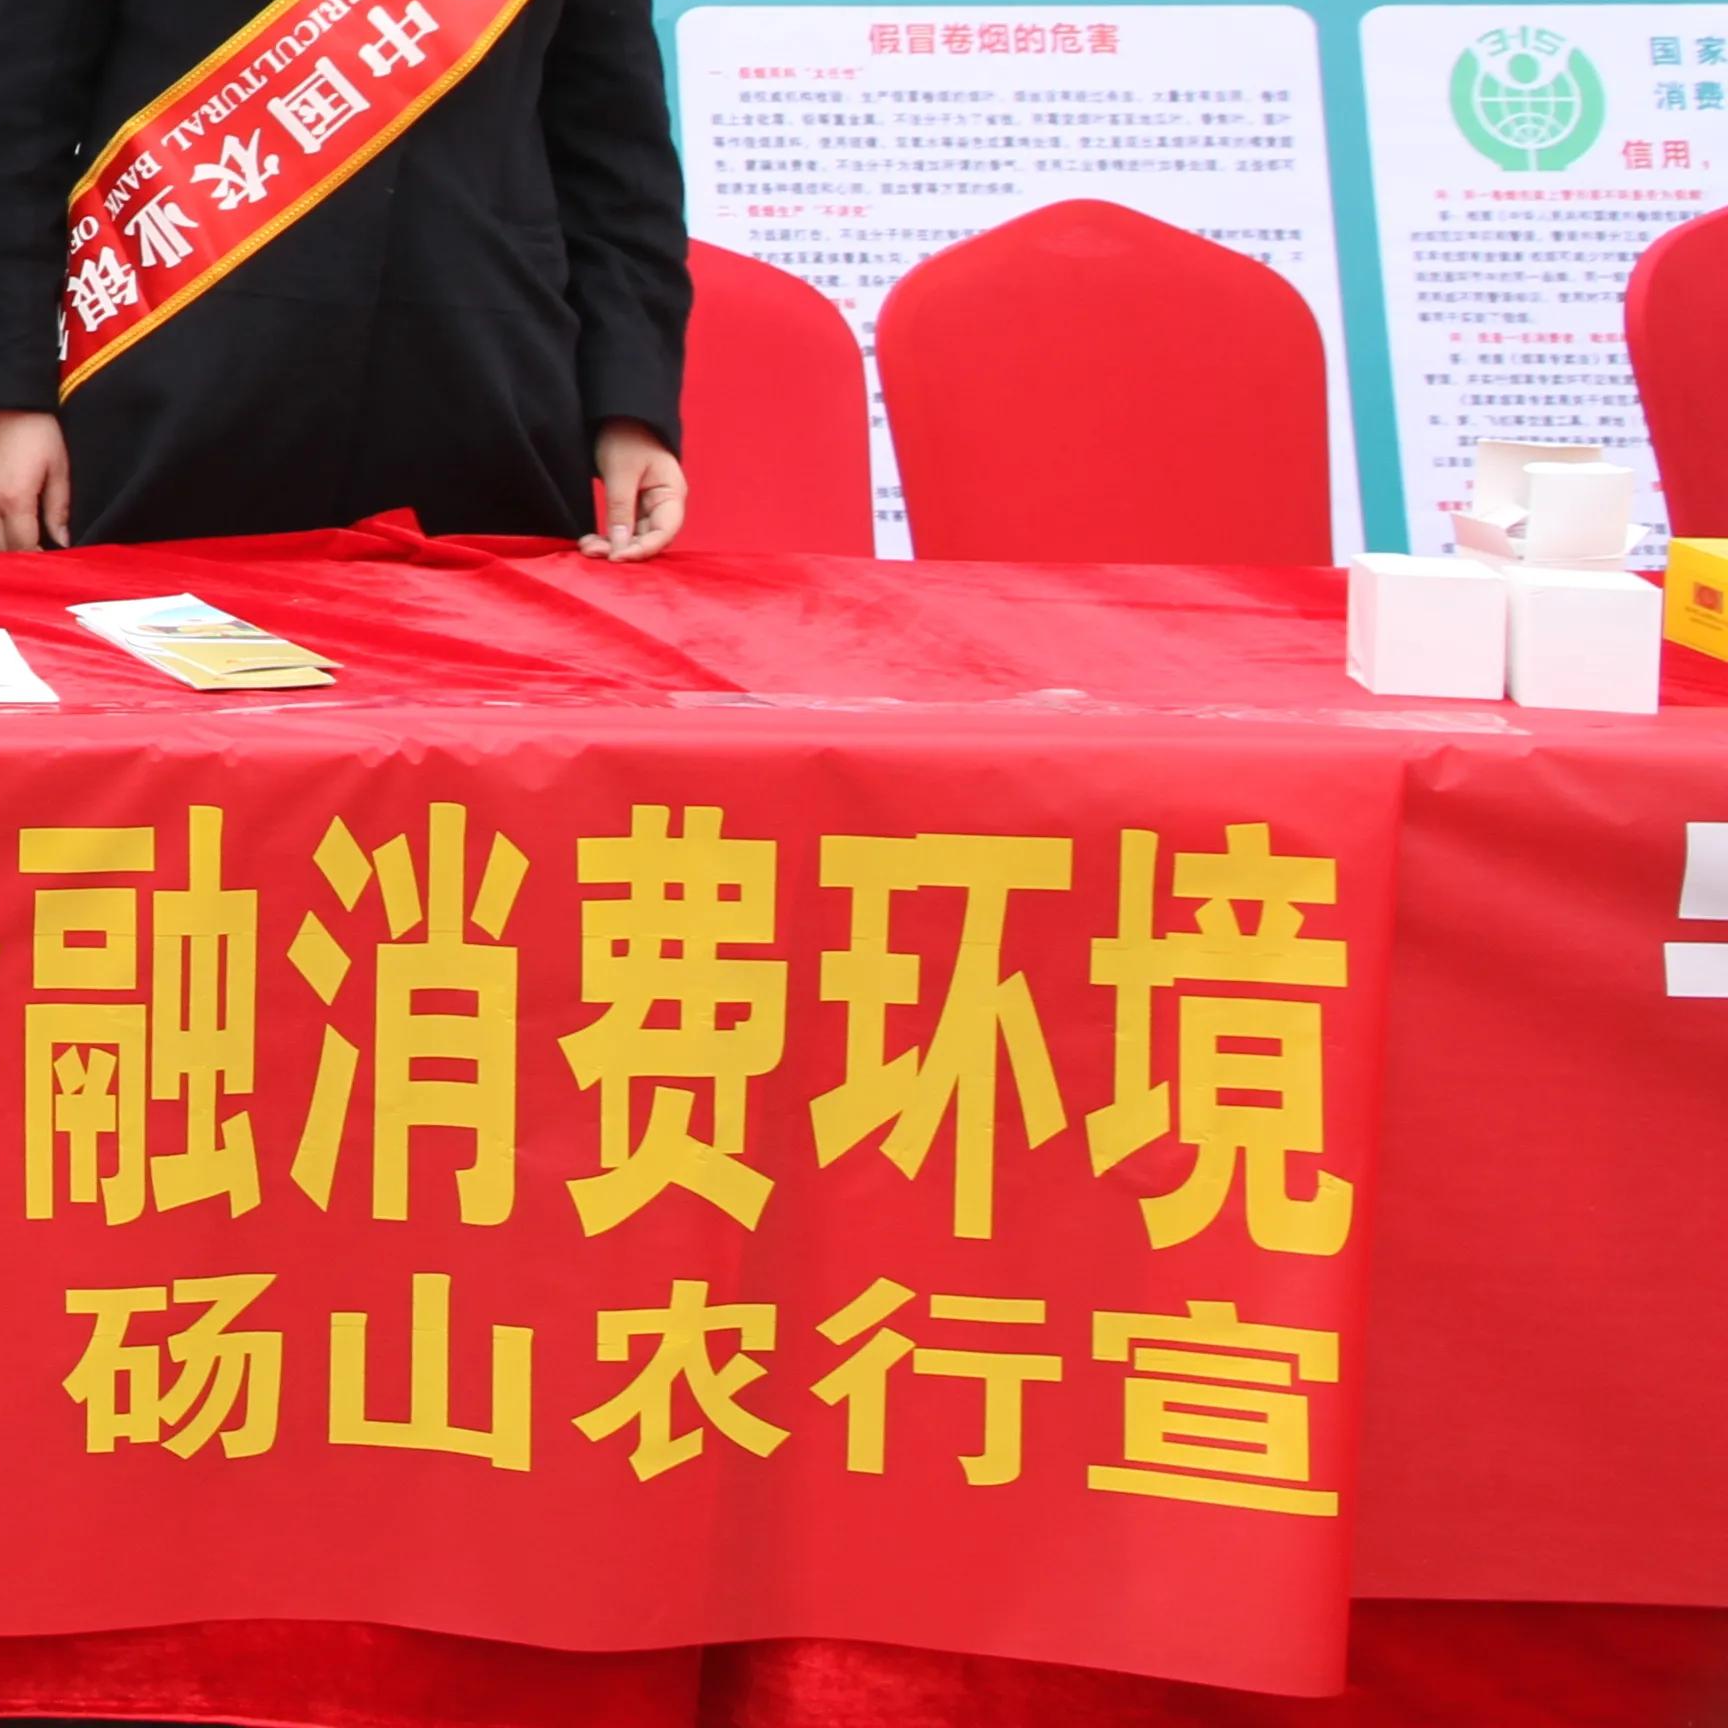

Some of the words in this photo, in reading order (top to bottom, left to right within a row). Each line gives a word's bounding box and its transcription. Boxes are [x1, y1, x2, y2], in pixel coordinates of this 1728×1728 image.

[868, 23, 1121, 56] 假冒卷烟的危害
[57, 0, 440, 362] 中国农业银
[103, 149, 164, 223] BANK
[61, 1272, 1343, 1518] 砀山农行宣
